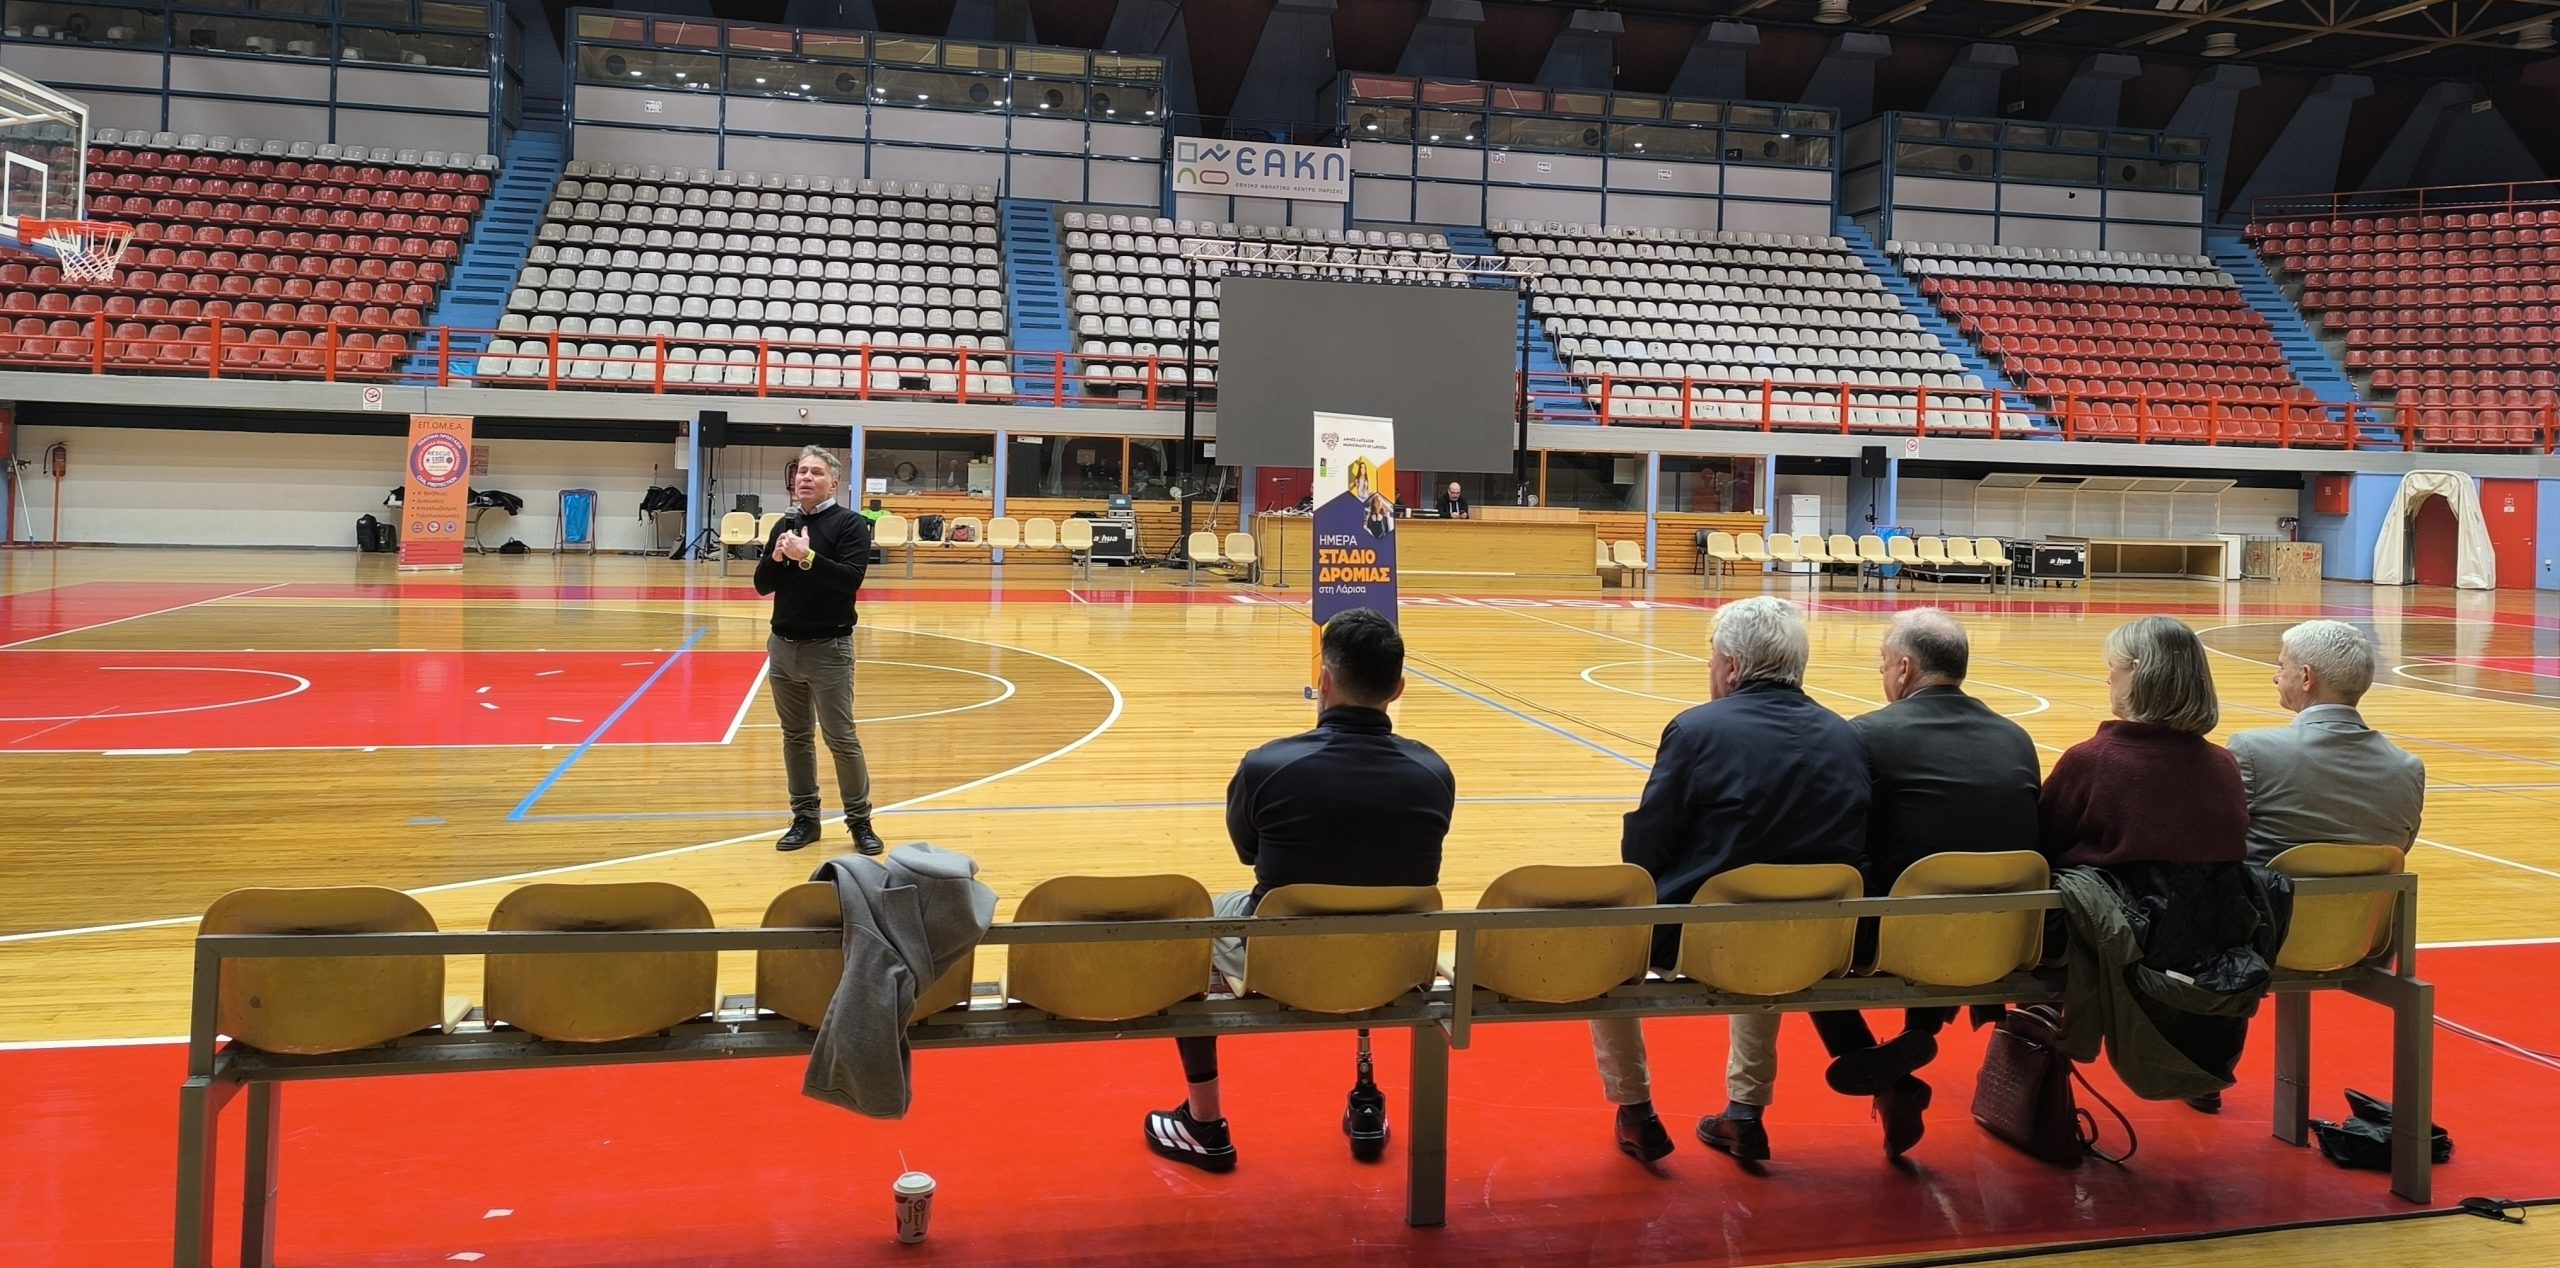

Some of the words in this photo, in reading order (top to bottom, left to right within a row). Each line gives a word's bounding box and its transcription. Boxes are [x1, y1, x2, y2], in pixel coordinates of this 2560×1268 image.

[1319, 534, 1357, 546] ΗΜΕΡΑ
[1319, 549, 1376, 564] ΣΤΑΔΙΟ
[1319, 567, 1390, 582] ΔΡΟΜΙΑΣ
[1319, 586, 1334, 596] στη
[1336, 584, 1366, 595] Λάρισα
